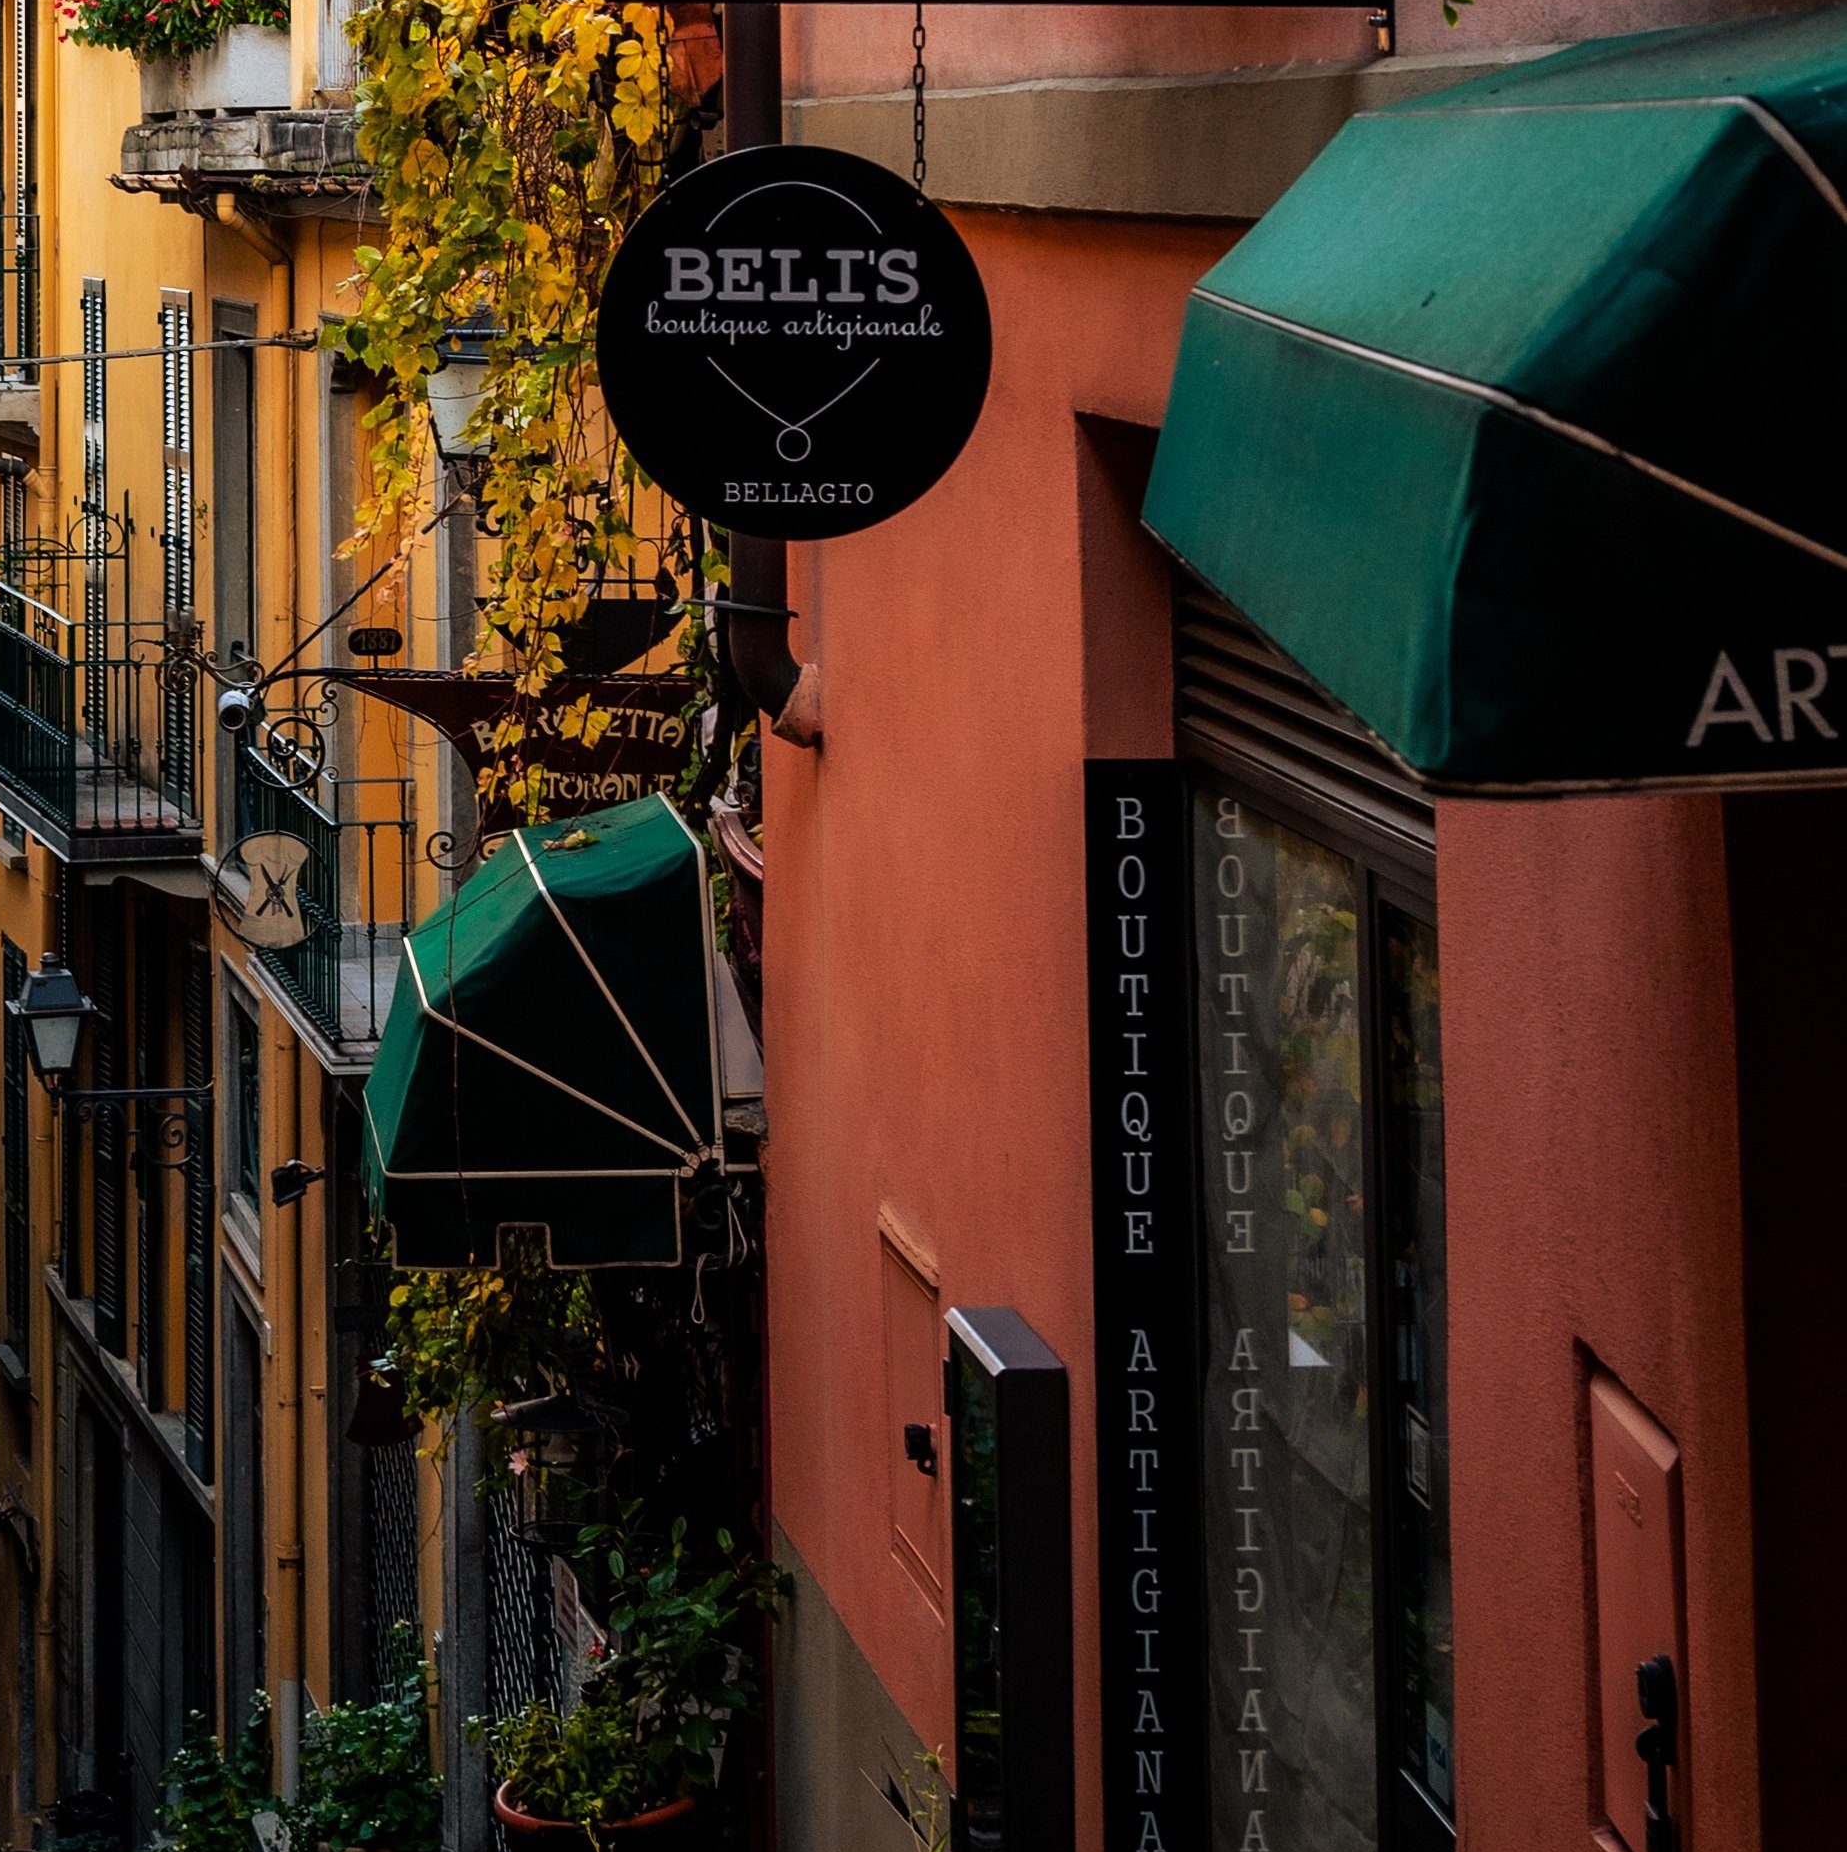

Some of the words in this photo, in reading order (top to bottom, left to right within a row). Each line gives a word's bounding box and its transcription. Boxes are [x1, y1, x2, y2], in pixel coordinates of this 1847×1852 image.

[663, 247, 920, 304] BELI'S
[644, 301, 771, 345] boutique
[782, 303, 944, 351] artigianale
[723, 481, 875, 505] BELLAGIO
[1684, 643, 1847, 749] AR
[1115, 796, 1155, 1255] BOUTIQUE
